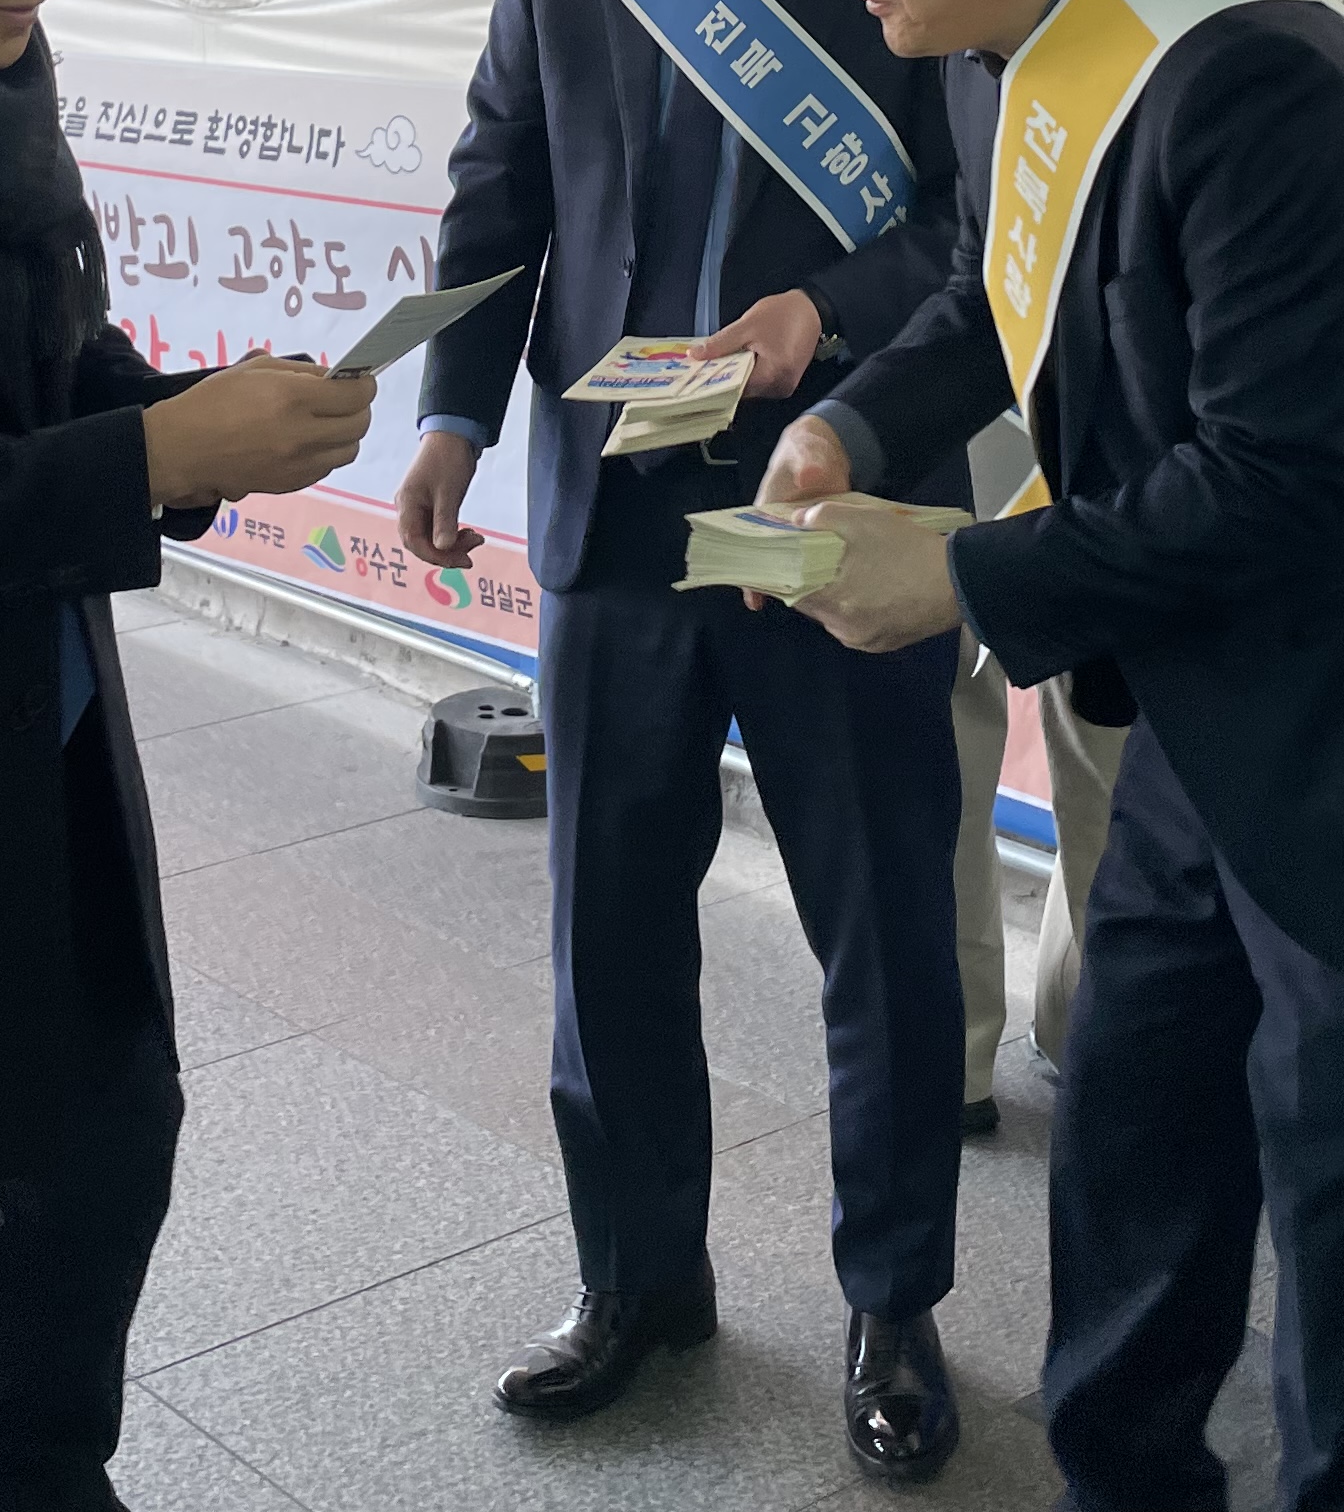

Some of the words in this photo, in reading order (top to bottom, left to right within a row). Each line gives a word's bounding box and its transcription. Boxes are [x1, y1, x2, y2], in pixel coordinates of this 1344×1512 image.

[694, 0, 784, 89] 전북
[95, 99, 200, 147] 진심으로
[203, 109, 346, 169] 환영합니다
[217, 218, 368, 318] 고향도
[243, 517, 286, 549] 무주군
[349, 535, 408, 588] 장수군
[477, 576, 533, 619] 임실군
